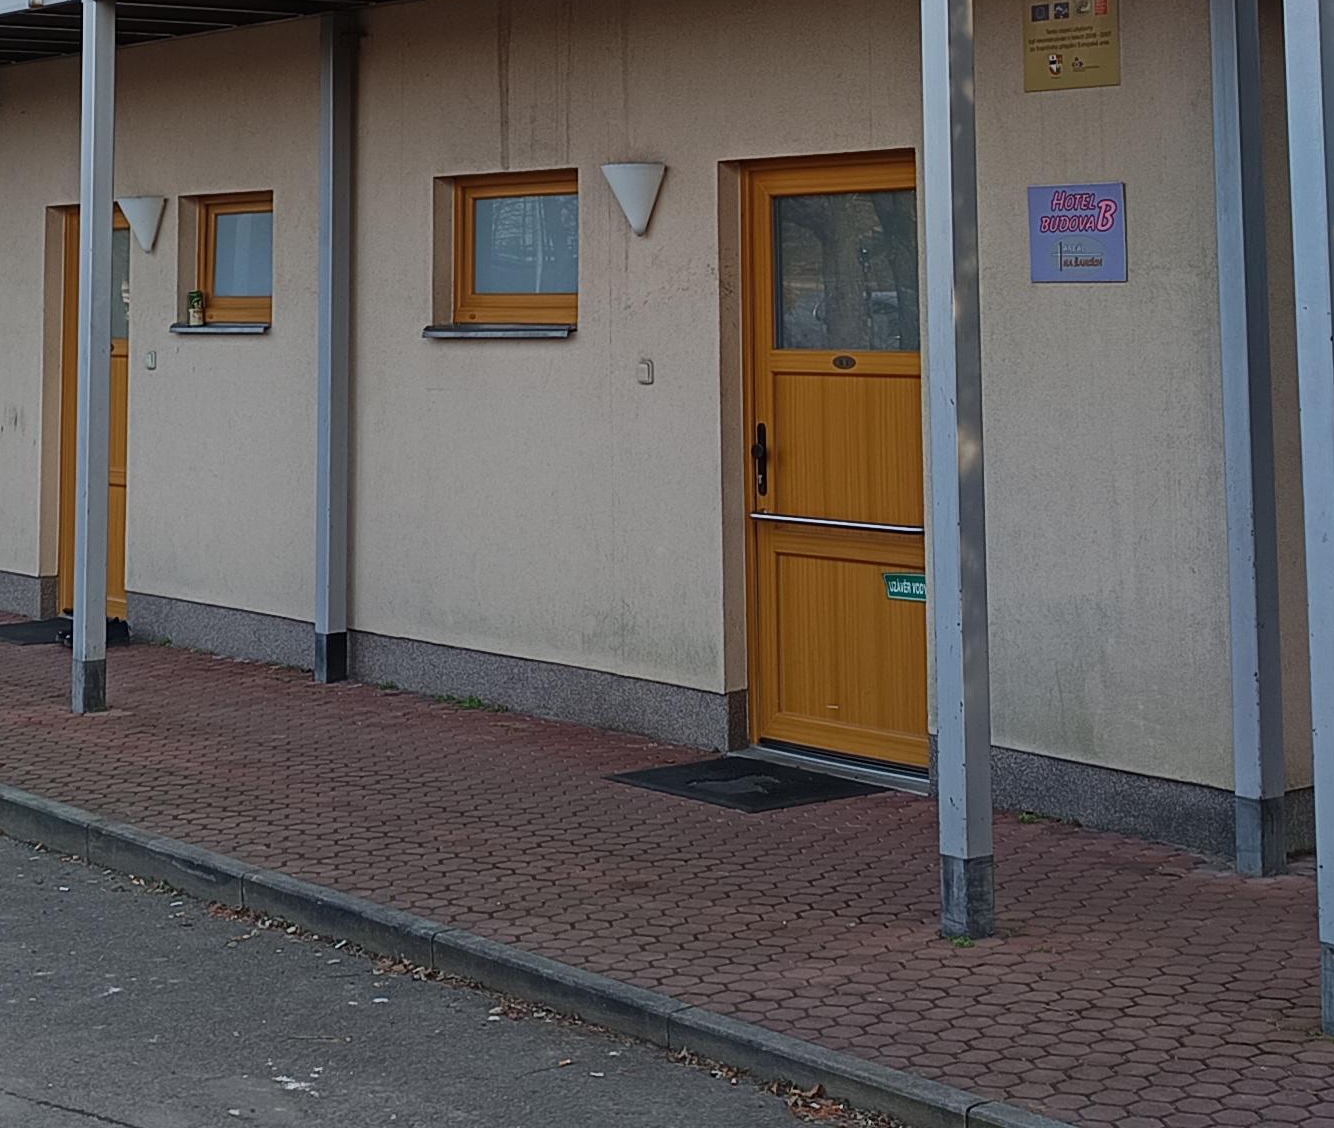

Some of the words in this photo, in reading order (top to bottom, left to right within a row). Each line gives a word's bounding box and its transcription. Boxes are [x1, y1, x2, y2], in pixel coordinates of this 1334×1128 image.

[1051, 190, 1096, 211] HOTEL
[1040, 215, 1096, 233] BUDOVA
[1096, 199, 1117, 233] B
